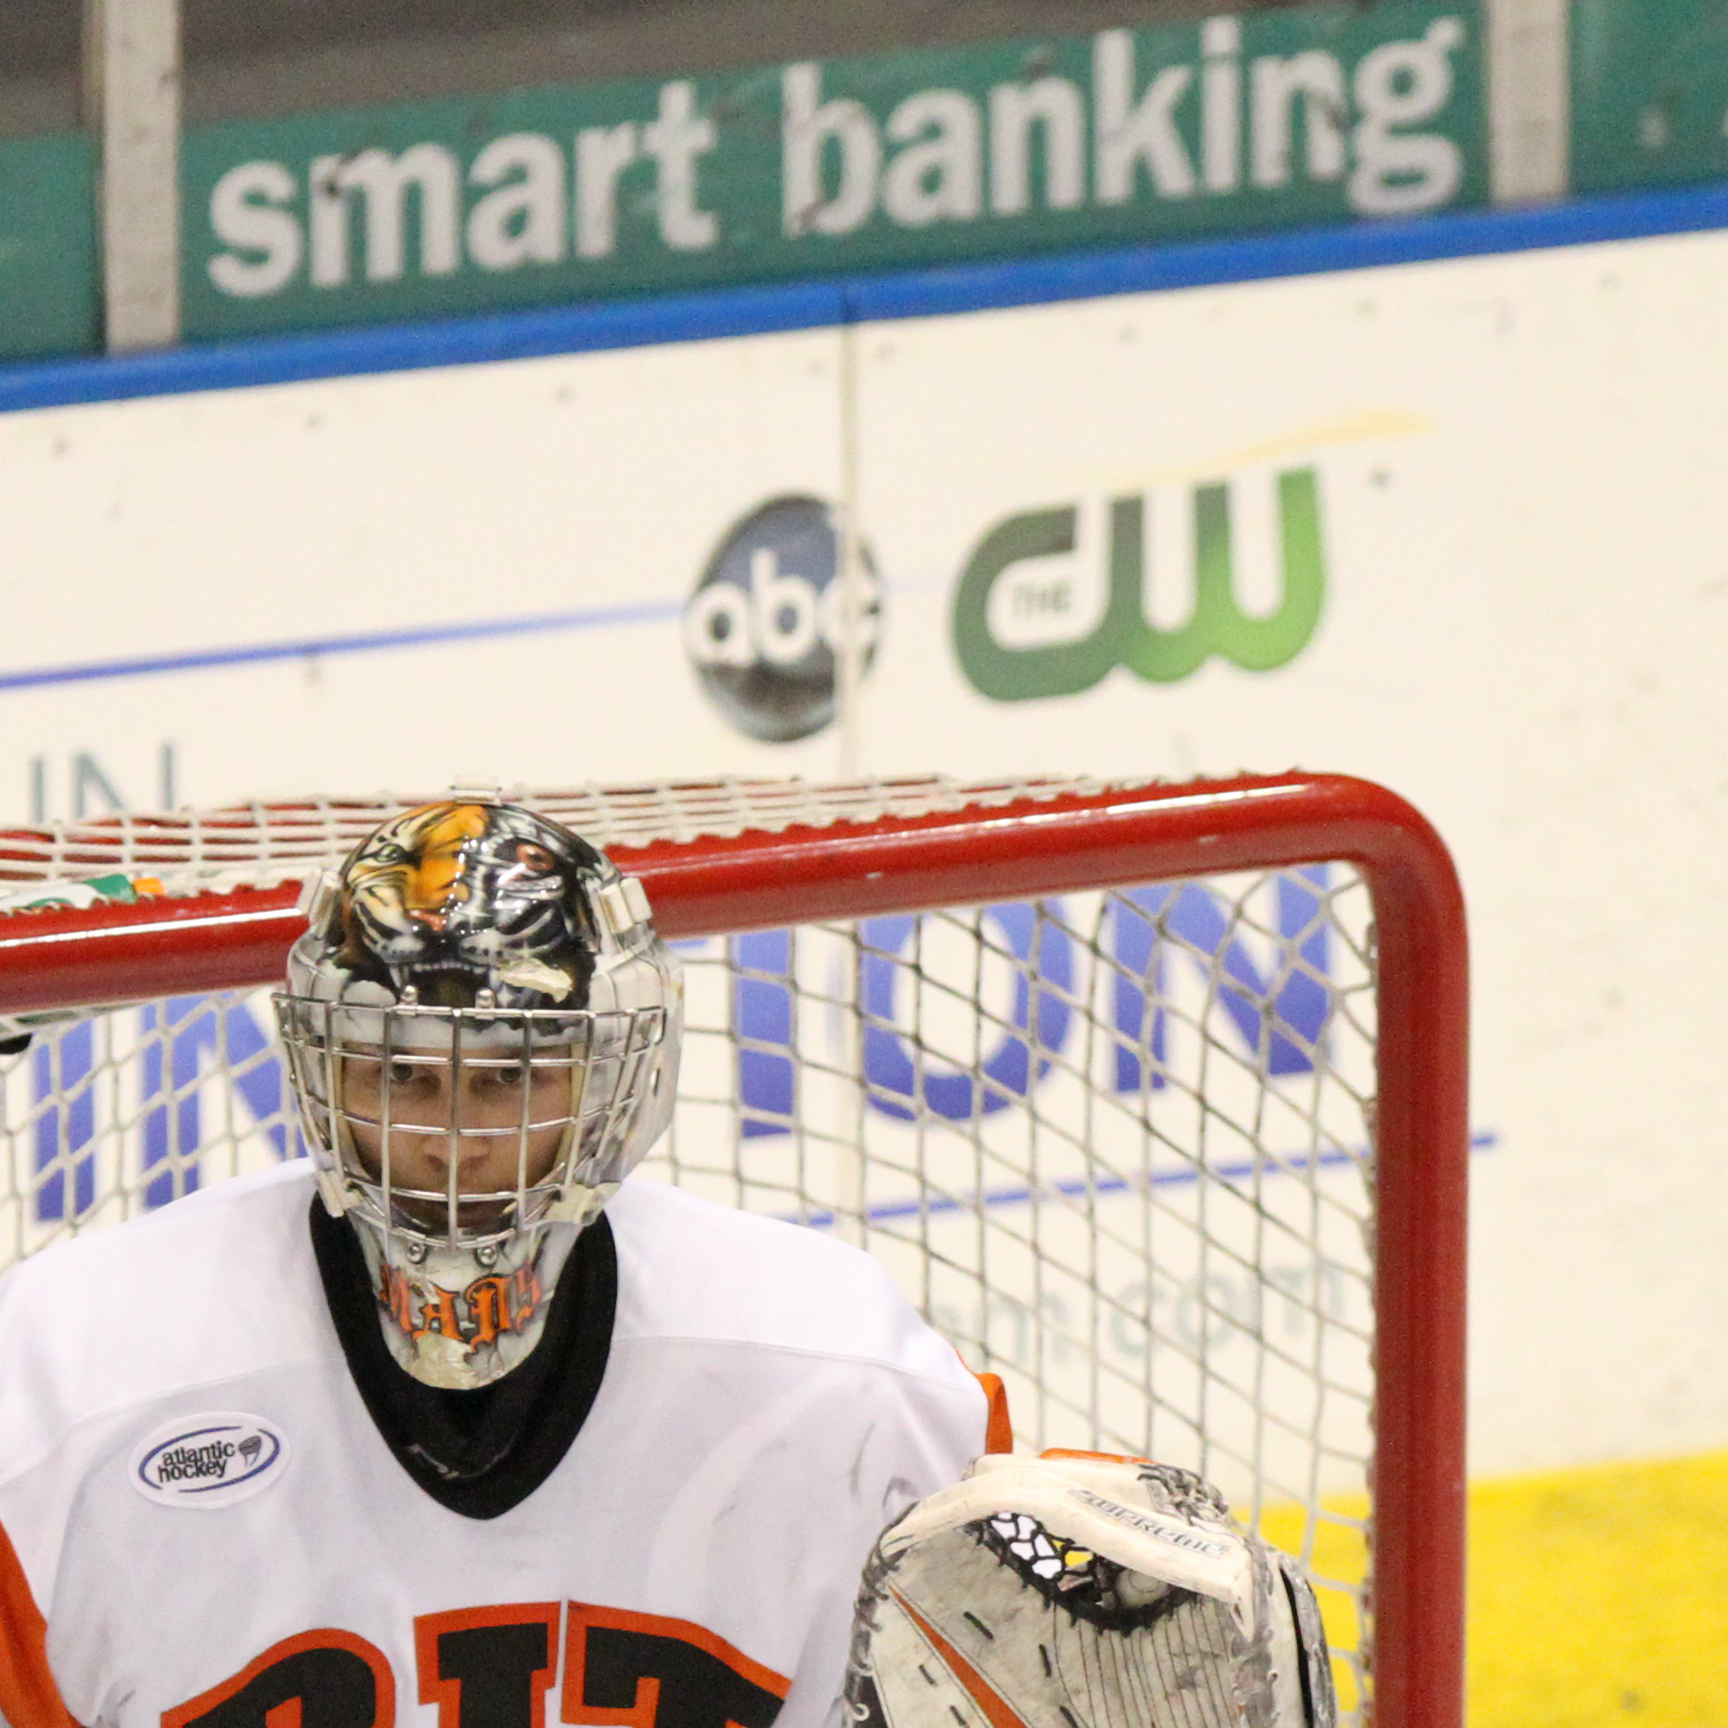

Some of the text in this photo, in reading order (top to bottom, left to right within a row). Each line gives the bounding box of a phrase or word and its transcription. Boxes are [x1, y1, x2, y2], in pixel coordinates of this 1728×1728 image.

[207, 16, 1469, 298] smart banking
[687, 548, 883, 663] abc
[951, 465, 1328, 704] CW
[157, 1459, 228, 1483] hockey
[161, 1439, 236, 1467] atlantic
